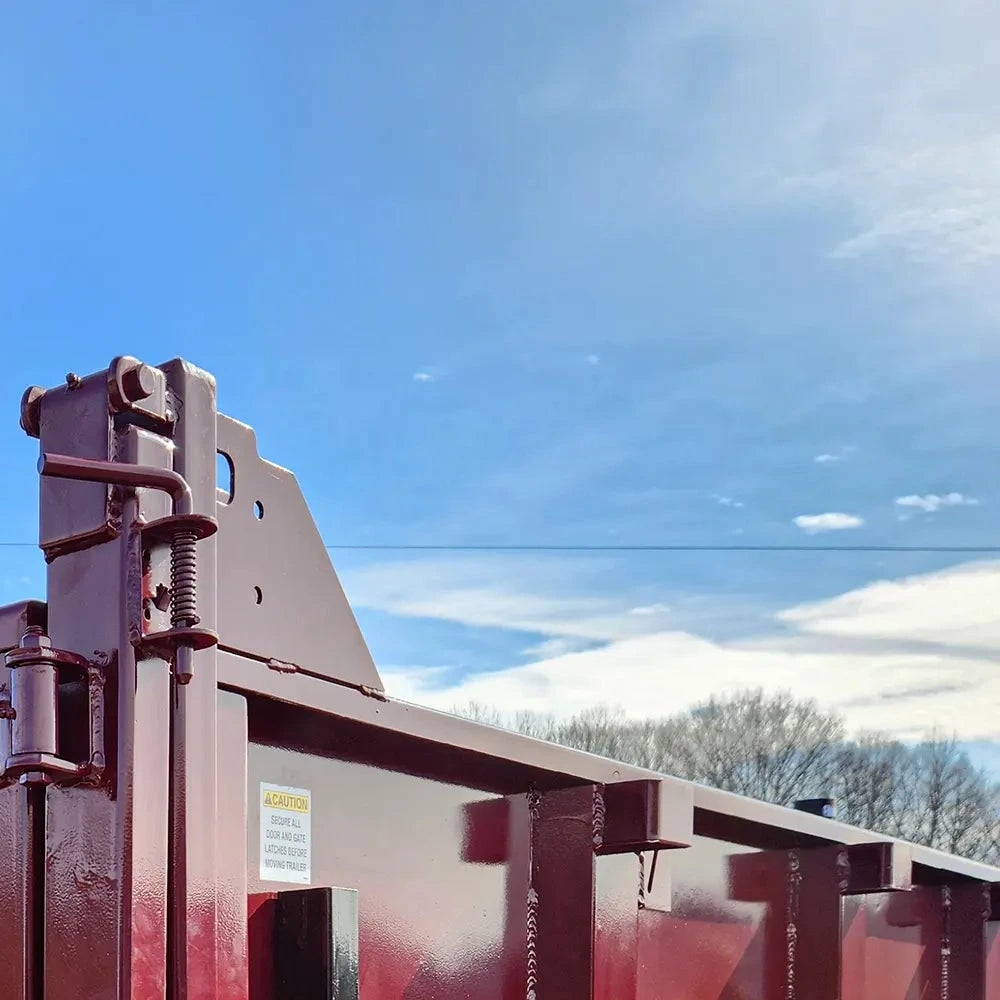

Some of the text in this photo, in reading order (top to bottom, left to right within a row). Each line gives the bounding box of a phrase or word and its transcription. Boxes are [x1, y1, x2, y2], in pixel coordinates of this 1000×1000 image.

[272, 794, 308, 810] CAUTION
[271, 815, 301, 828] SECURE ALL
[266, 829, 280, 840] DOOR
[281, 832, 292, 842] AND
[265, 844, 307, 857] LATCHES BEFORE
[265, 858, 307, 871] MOVING TRAILER
